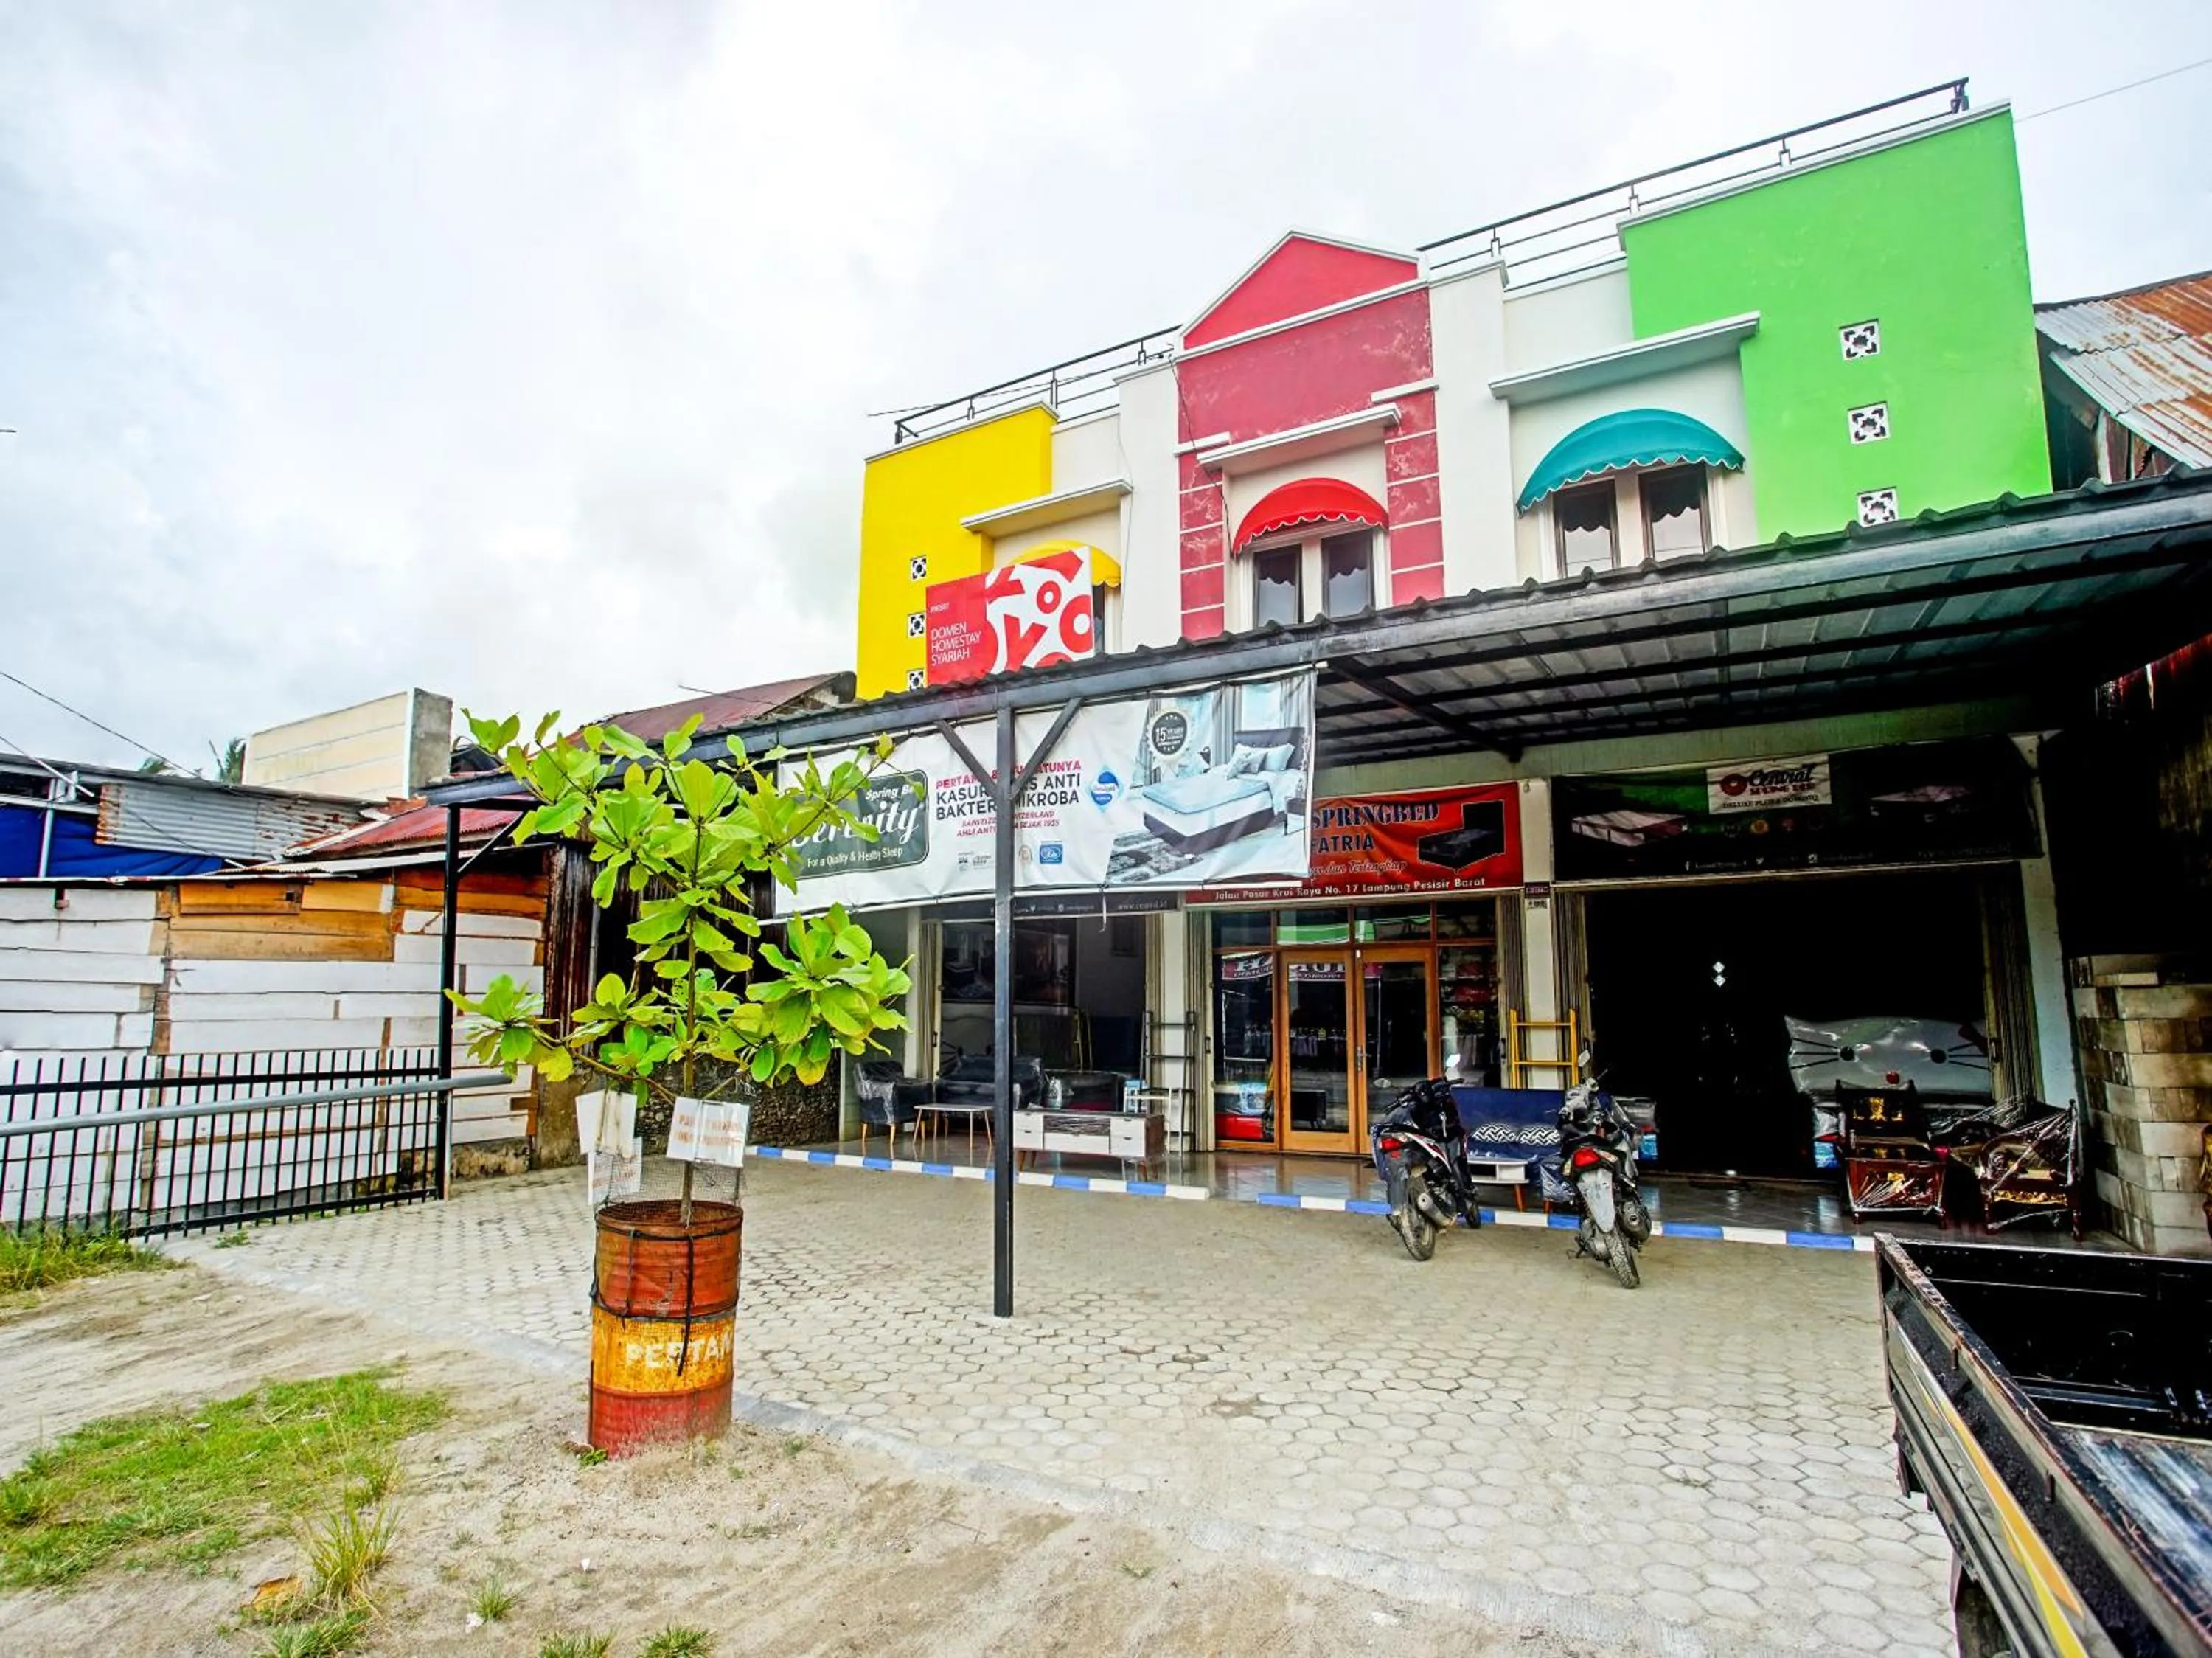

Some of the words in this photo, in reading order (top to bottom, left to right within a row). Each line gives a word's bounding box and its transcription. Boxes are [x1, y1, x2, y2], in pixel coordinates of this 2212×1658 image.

[931, 622, 967, 641] DOMEN
[931, 631, 981, 653] HOMESTAY
[931, 647, 970, 667] SYARIAH
[865, 788, 899, 802] Spring
[936, 784, 990, 806] KASUR
[1043, 772, 1080, 790] ANTI
[936, 799, 998, 821] BAKTER
[882, 847, 903, 859] Sleep
[1312, 833, 1375, 853] ATRIA
[1242, 890, 1269, 898] Pasar
[1272, 888, 1293, 897] Krui
[1296, 887, 1322, 898] Raya
[1324, 885, 1341, 894] No.
[1346, 884, 1358, 892] 17
[1362, 882, 1411, 894] Lampung
[1413, 879, 1450, 890] Pesisir
[1454, 877, 1486, 888] Barat
